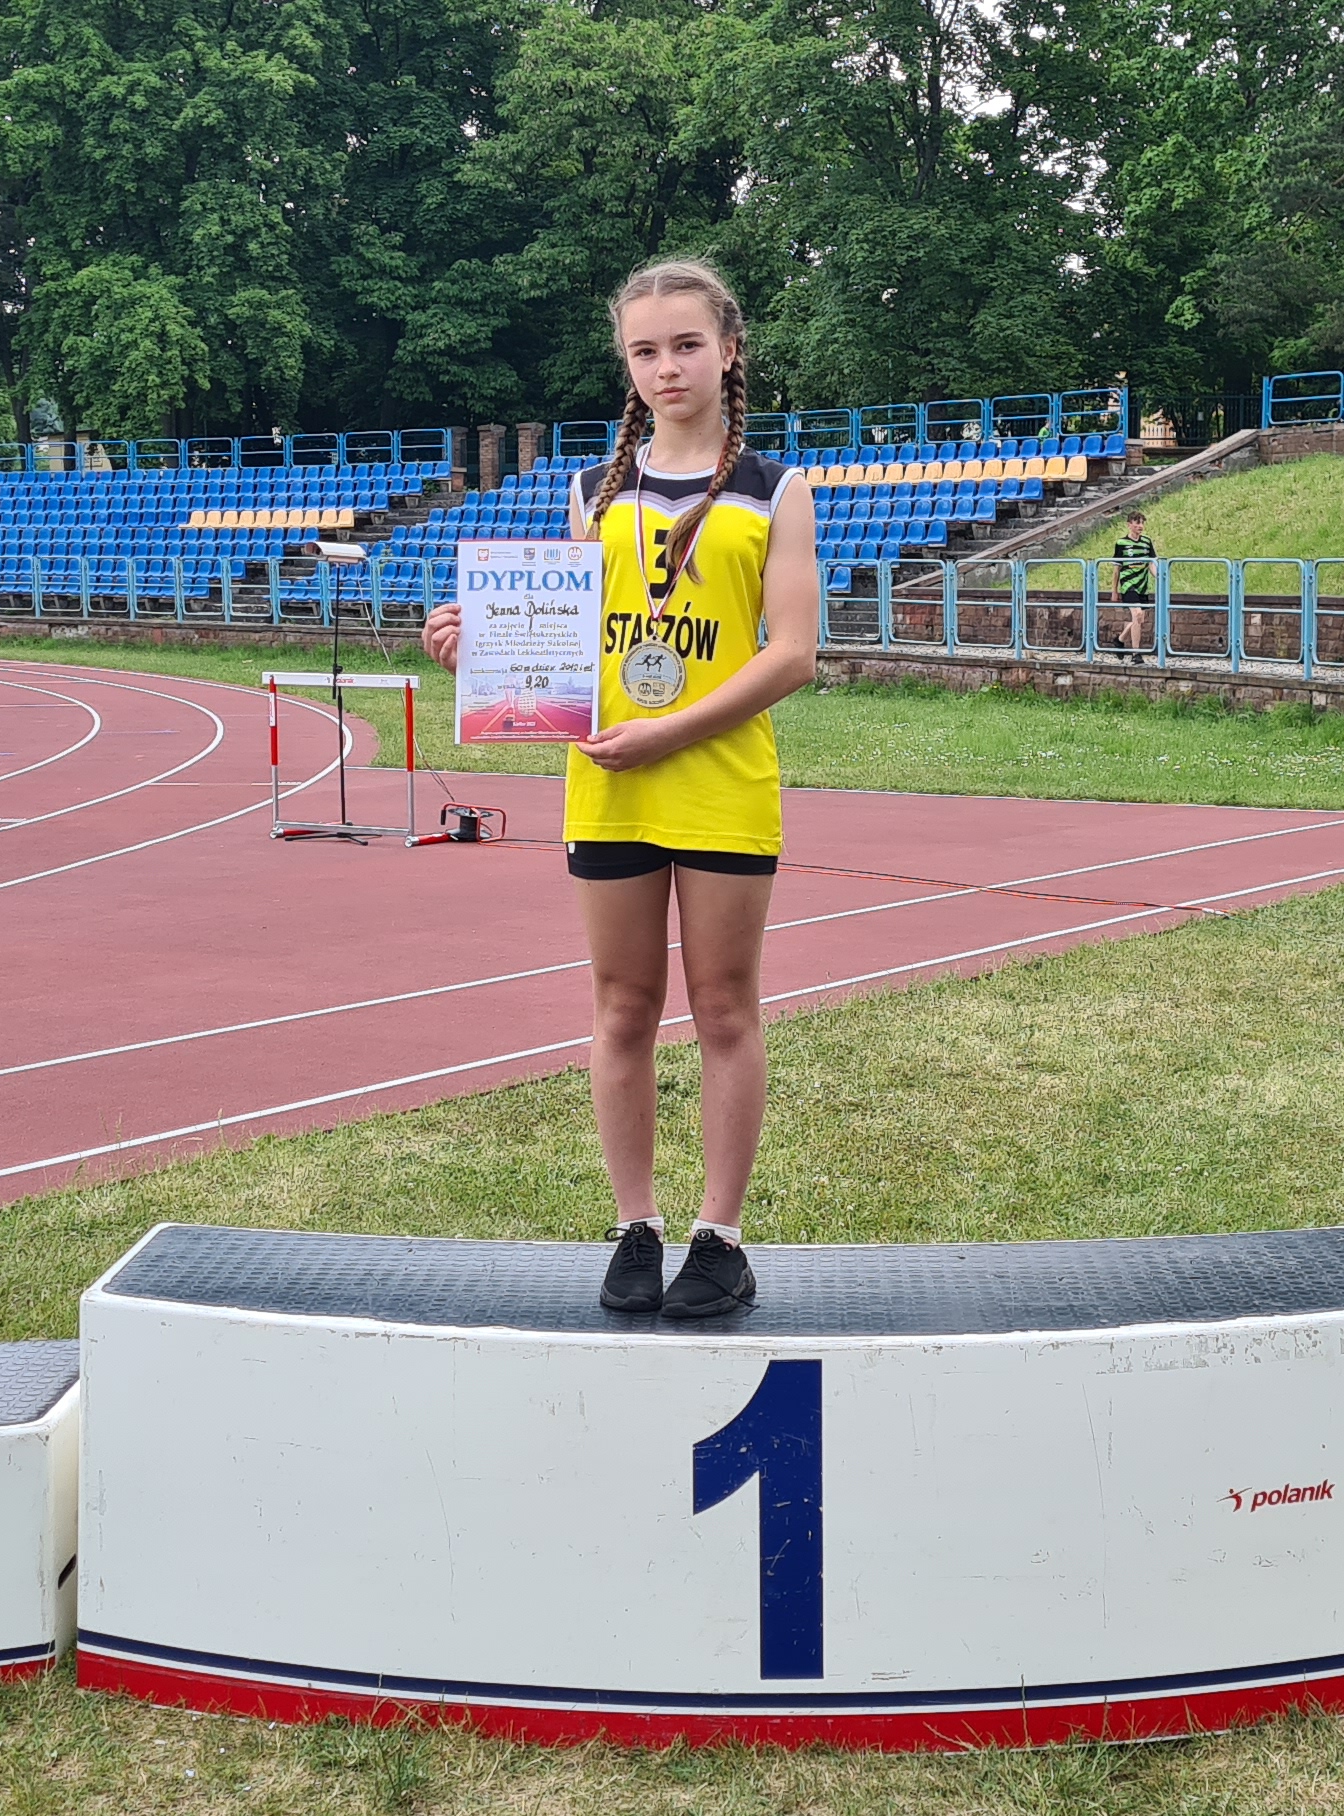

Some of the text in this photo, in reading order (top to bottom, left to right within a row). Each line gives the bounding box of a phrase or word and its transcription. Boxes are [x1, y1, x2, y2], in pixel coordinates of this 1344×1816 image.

[466, 570, 594, 592] DYPLOM
[649, 528, 678, 600] 3
[525, 674, 550, 690] 9,20
[1250, 1478, 1336, 1512] polanik
[693, 1359, 823, 1680] 1
